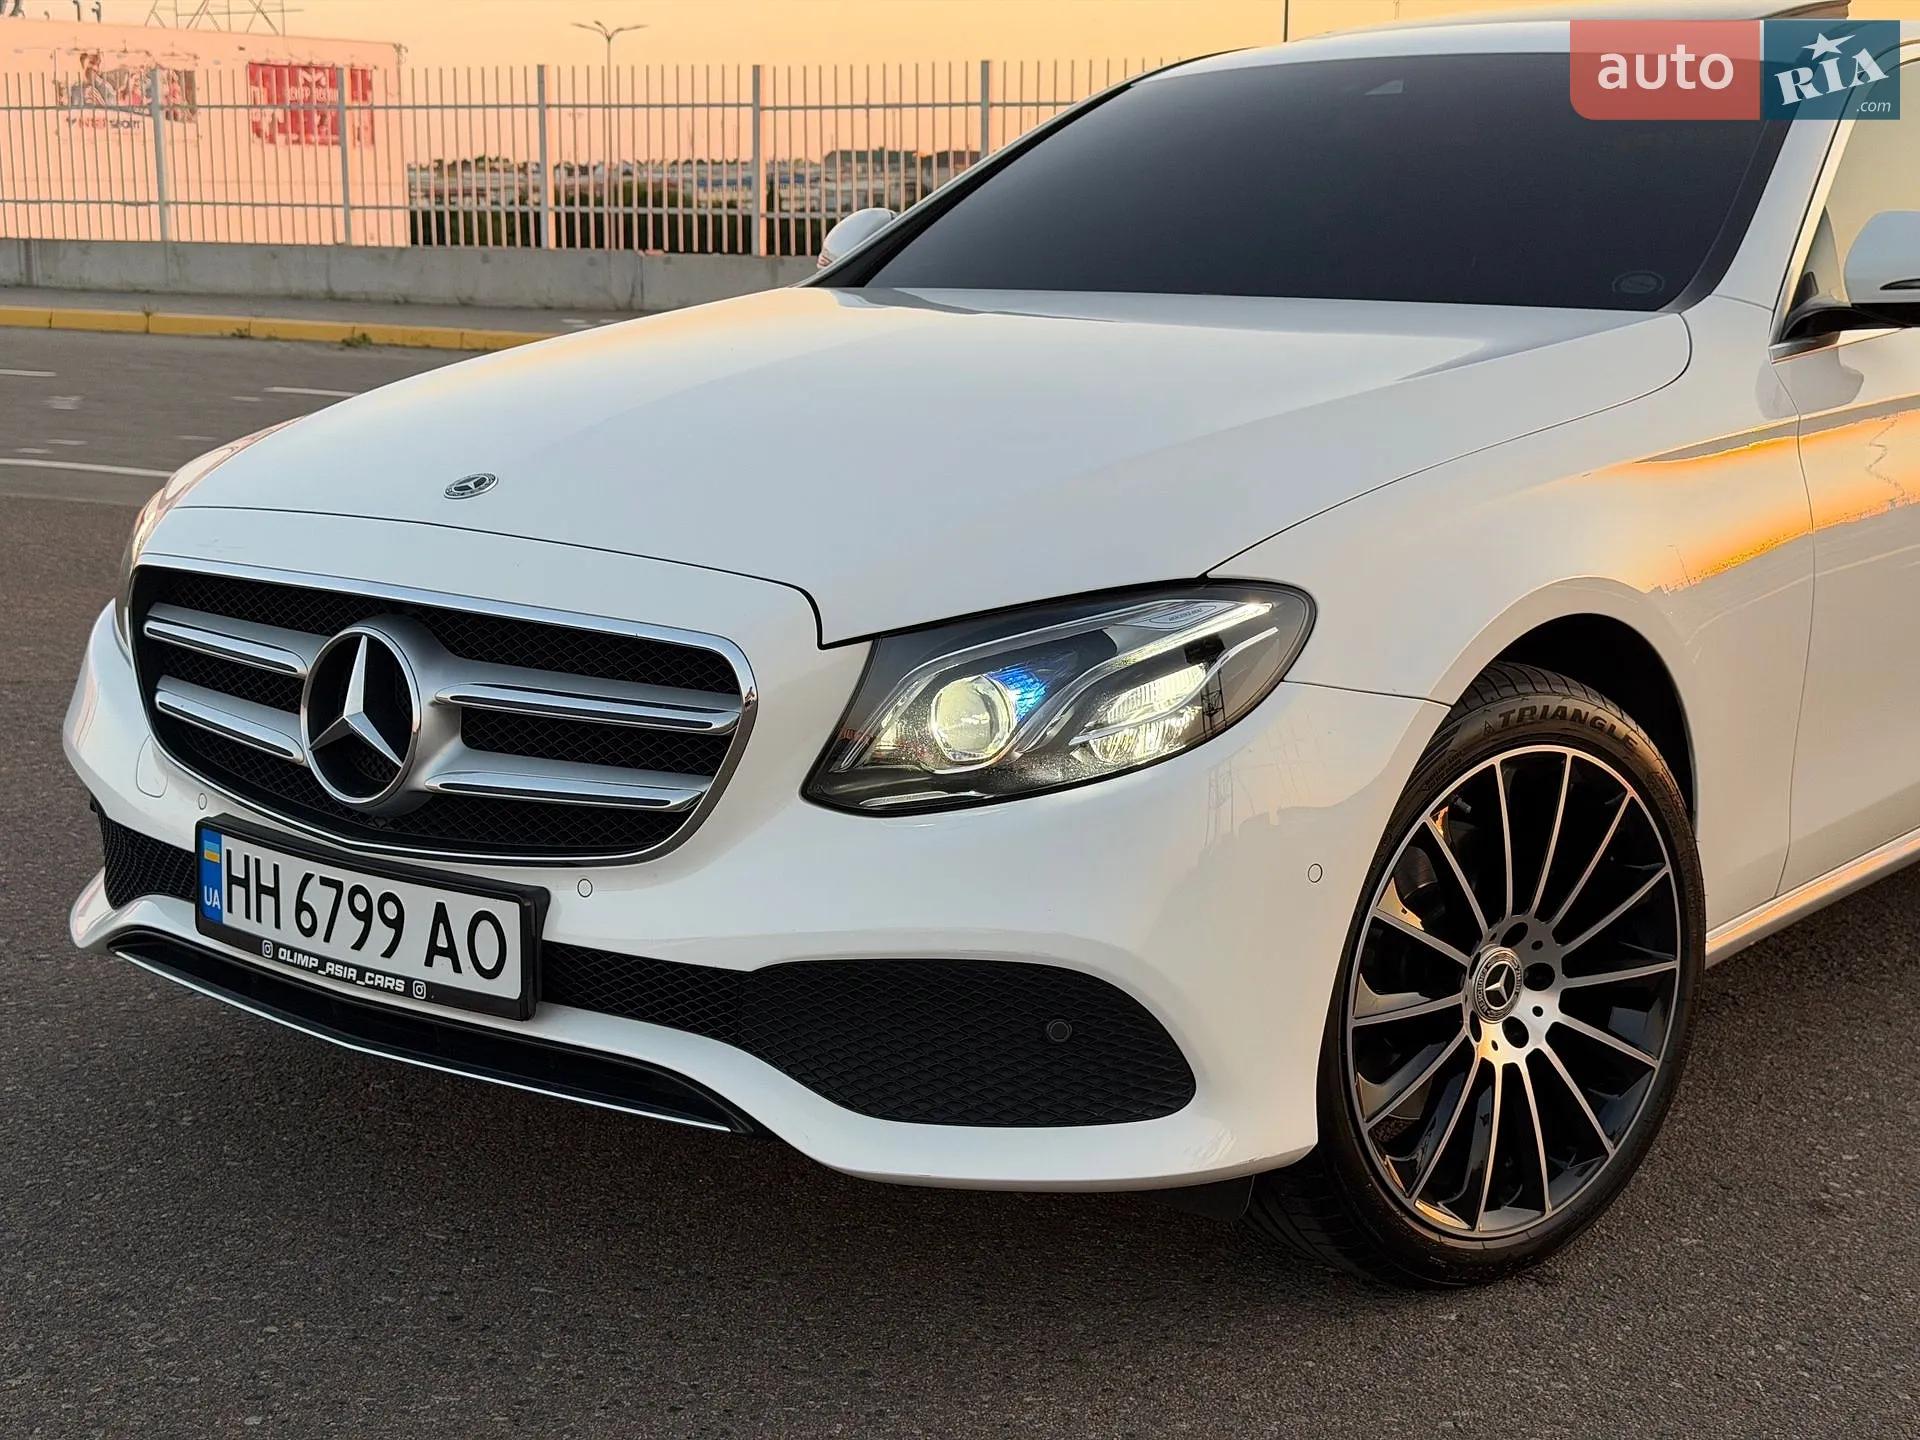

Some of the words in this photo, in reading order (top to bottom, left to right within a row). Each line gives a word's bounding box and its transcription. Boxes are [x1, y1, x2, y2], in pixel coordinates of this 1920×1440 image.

[1498, 704, 1639, 751] TRIANGLE
[203, 885, 221, 910] UA
[225, 848, 282, 930] HH
[294, 871, 406, 959] 6799
[423, 901, 508, 981] AO
[277, 946, 405, 993] OLIMP_ASIA_CARS
